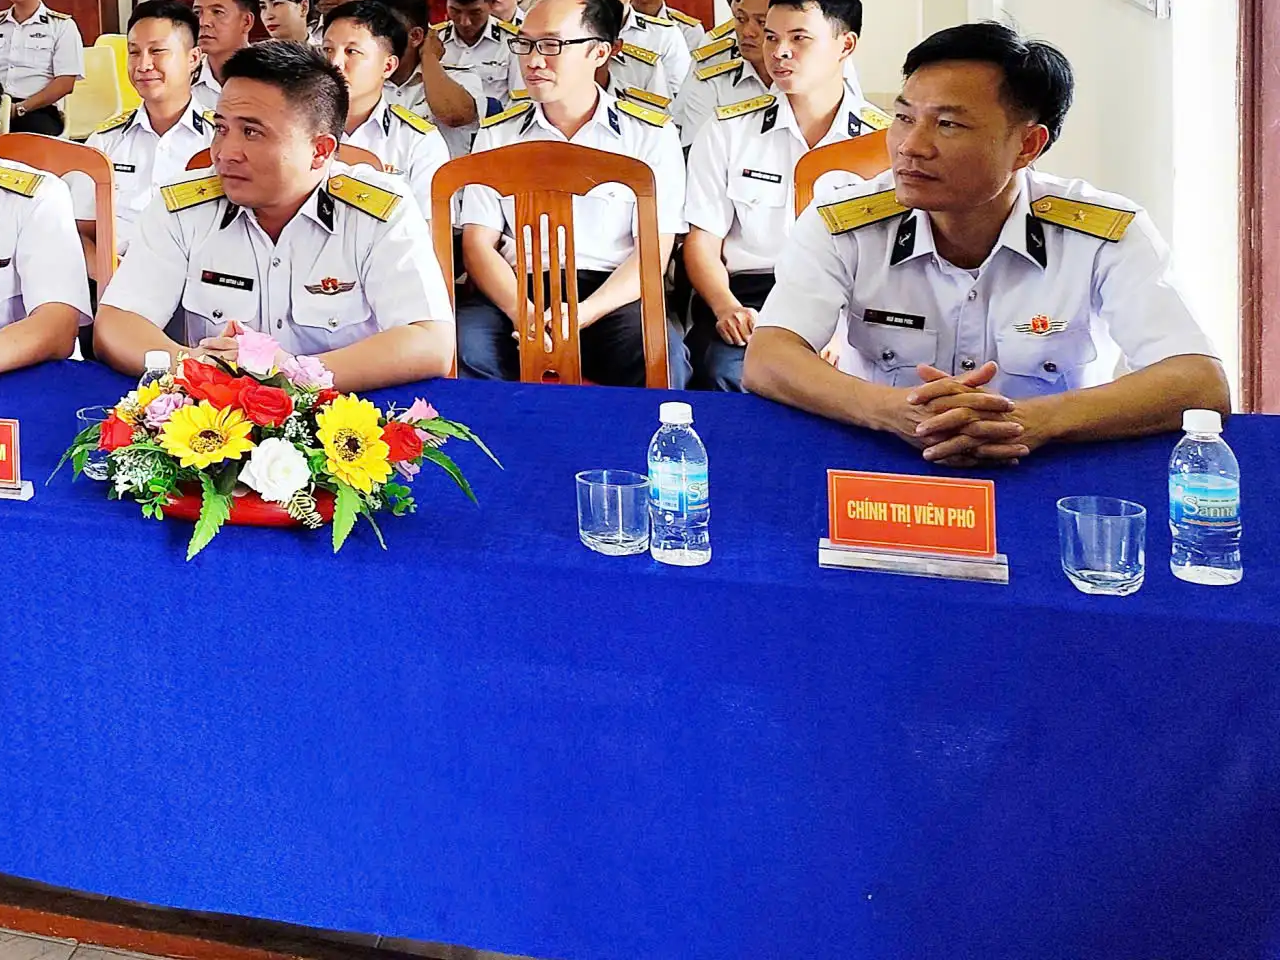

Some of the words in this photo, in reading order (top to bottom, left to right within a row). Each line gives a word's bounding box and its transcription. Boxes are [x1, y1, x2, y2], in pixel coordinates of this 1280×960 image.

[847, 497, 887, 521] CHÍNH
[889, 503, 911, 528] TRỊ
[913, 502, 945, 526] VIÊN
[947, 505, 975, 529] PHÓ
